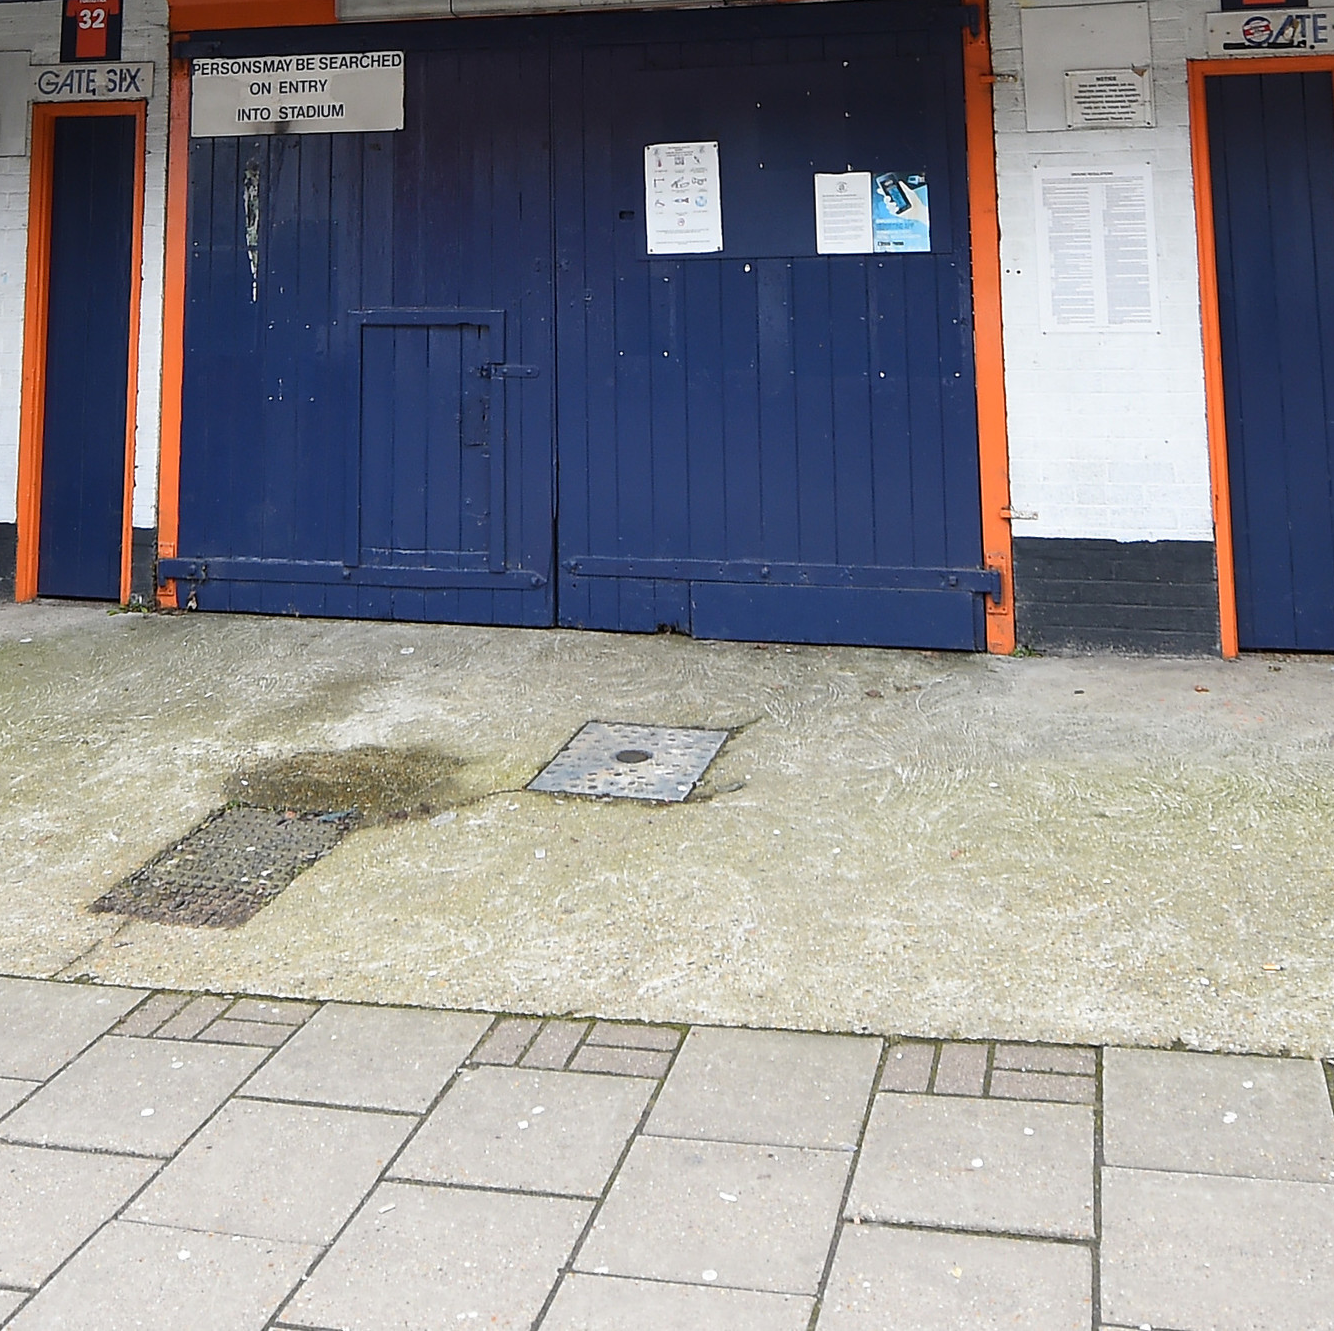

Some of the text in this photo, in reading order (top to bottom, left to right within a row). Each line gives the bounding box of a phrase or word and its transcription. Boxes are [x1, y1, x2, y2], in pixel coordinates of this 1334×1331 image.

[79, 8, 105, 29] 32
[295, 57, 316, 71] BE
[318, 53, 402, 70] SEARCHED
[38, 67, 142, 95] GATE SIX
[249, 79, 328, 95] ON ENTRY
[236, 103, 345, 122] INTO STADIUM
